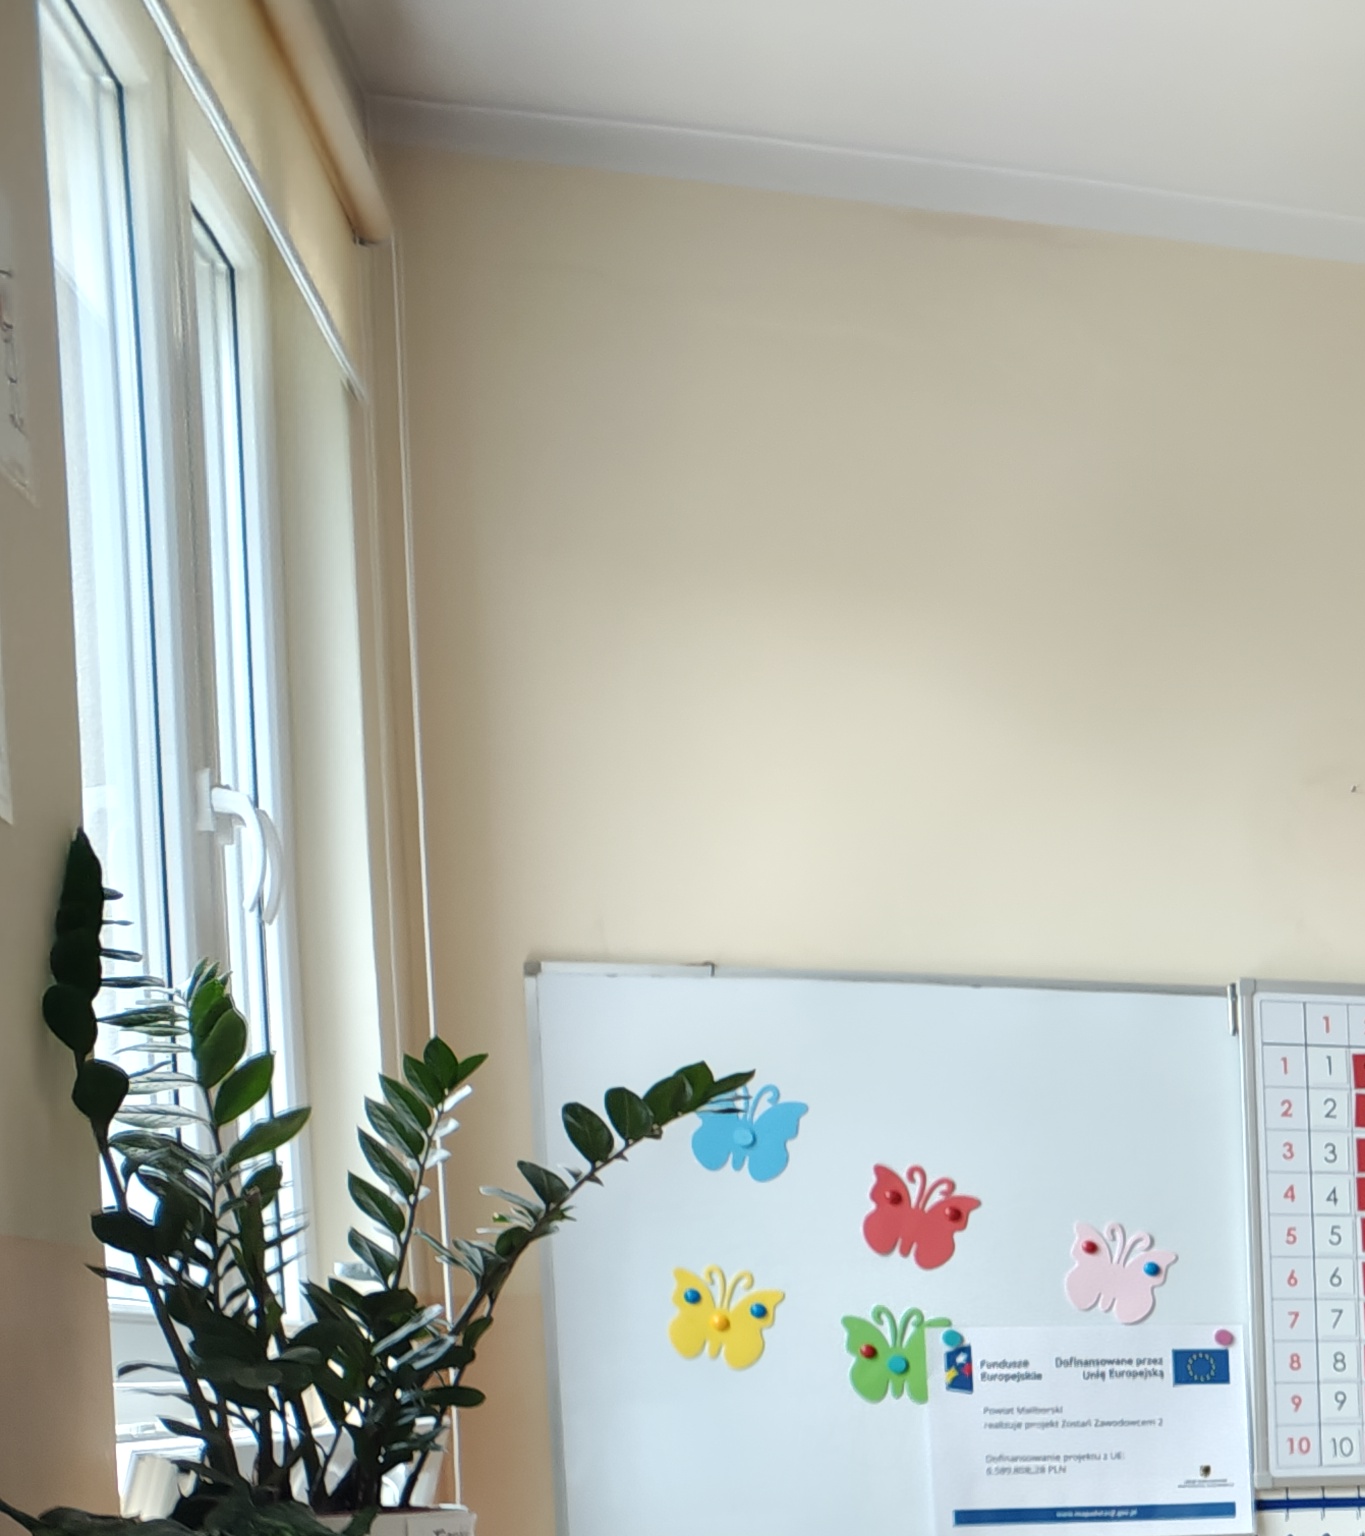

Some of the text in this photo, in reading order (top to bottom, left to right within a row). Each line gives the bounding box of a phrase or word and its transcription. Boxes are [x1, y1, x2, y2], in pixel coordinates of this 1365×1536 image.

[1281, 1057, 1288, 1075] 1
[1326, 1055, 1332, 1075] 1
[1281, 1099, 1292, 1117] 2
[1324, 1098, 1337, 1119] 2
[1282, 1142, 1294, 1160] 3
[1324, 1143, 1337, 1163] 3
[1283, 1185, 1295, 1202] 4
[1326, 1187, 1338, 1205] 4
[1286, 1227, 1297, 1245] 5
[1329, 1225, 1342, 1246] 5
[1287, 1269, 1298, 1287] 6
[1329, 1267, 1342, 1287] 6
[1288, 1311, 1299, 1329] 7
[1331, 1309, 1343, 1329] 7
[980, 1359, 1030, 1369] Fundusze
[1055, 1356, 1163, 1368] Dofinansowane przez
[1289, 1353, 1301, 1371] 8
[1333, 1351, 1346, 1372] 8
[980, 1371, 1042, 1383] Europejskie
[1291, 1395, 1302, 1412] 9
[1334, 1391, 1347, 1411] 9
[1287, 1437, 1311, 1455] 10
[1331, 1437, 1354, 1457] 10
